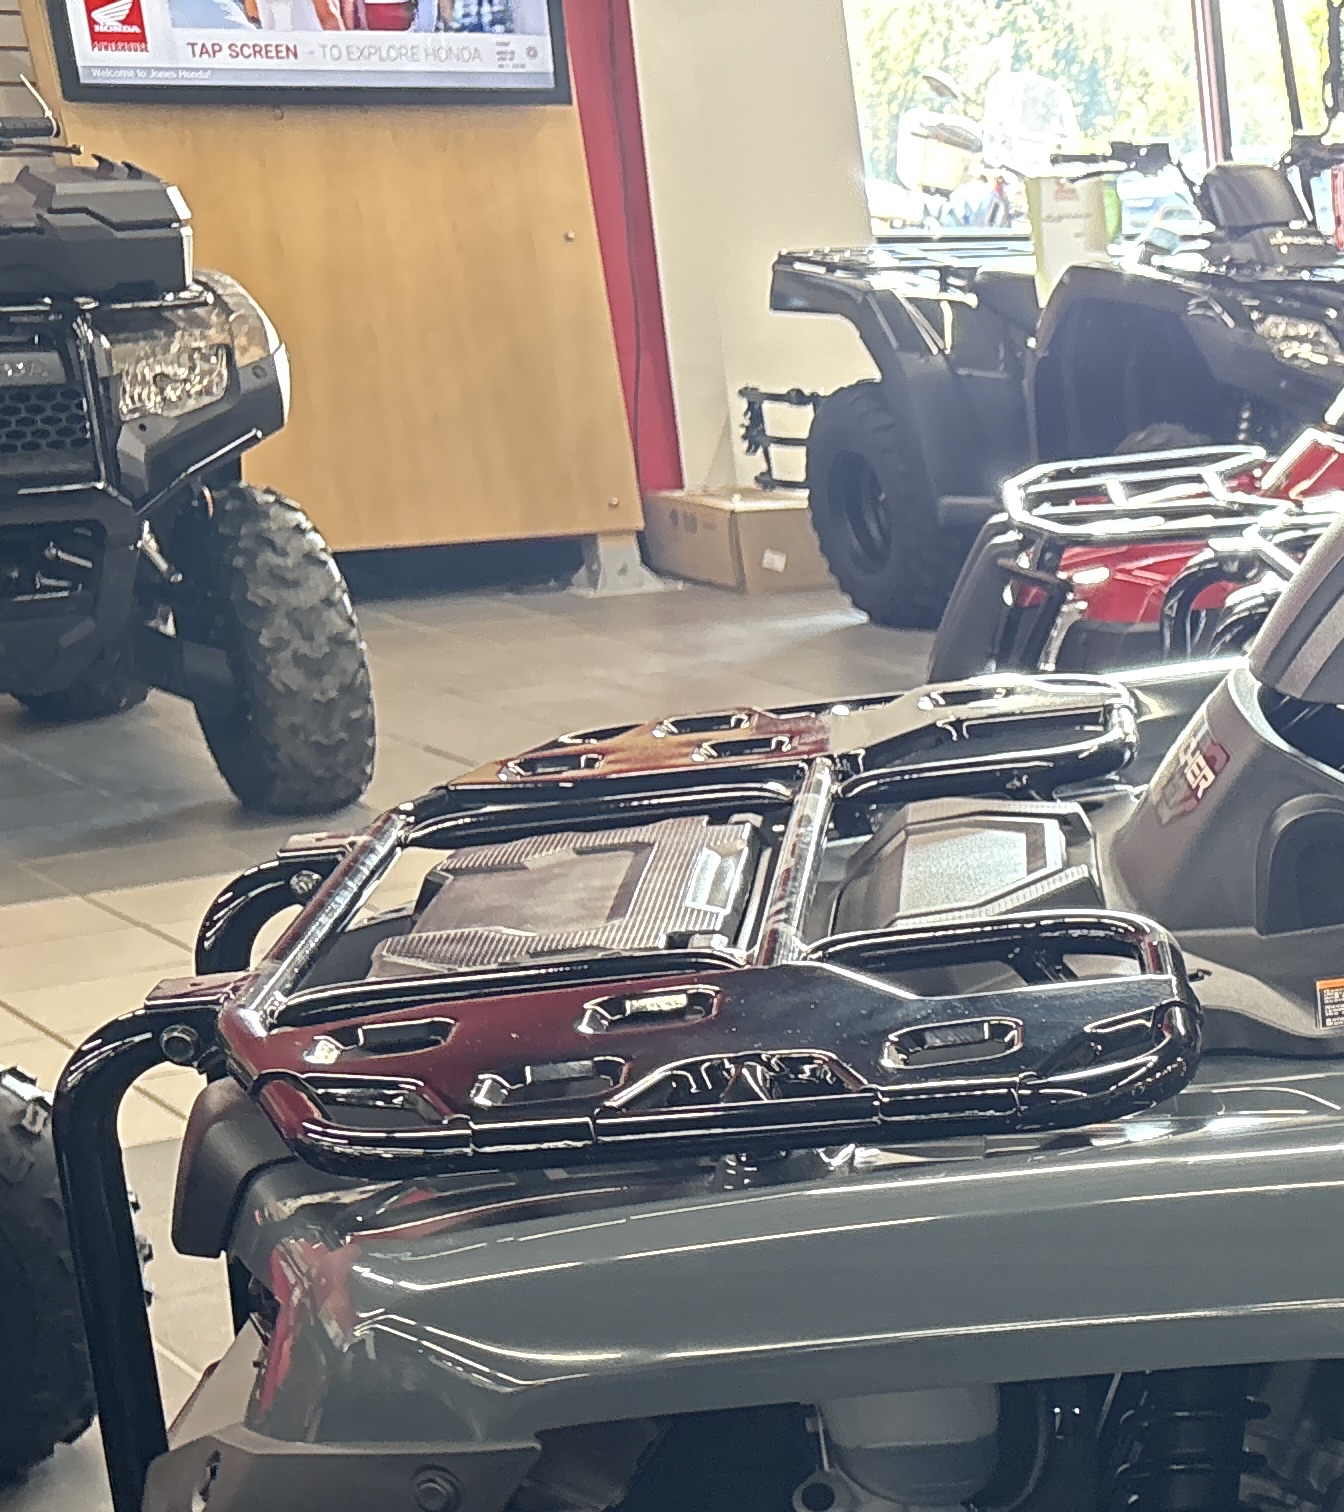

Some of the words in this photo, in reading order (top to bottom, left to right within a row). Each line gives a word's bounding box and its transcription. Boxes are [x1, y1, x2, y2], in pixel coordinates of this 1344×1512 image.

[94, 24, 141, 33] HONDA
[187, 42, 223, 58] TAP
[229, 43, 298, 60] SCREEN
[320, 44, 342, 60] TO
[349, 44, 420, 62] EXPLORE
[424, 46, 482, 63] HONDA
[91, 67, 135, 78] Welcome
[136, 69, 147, 78] to
